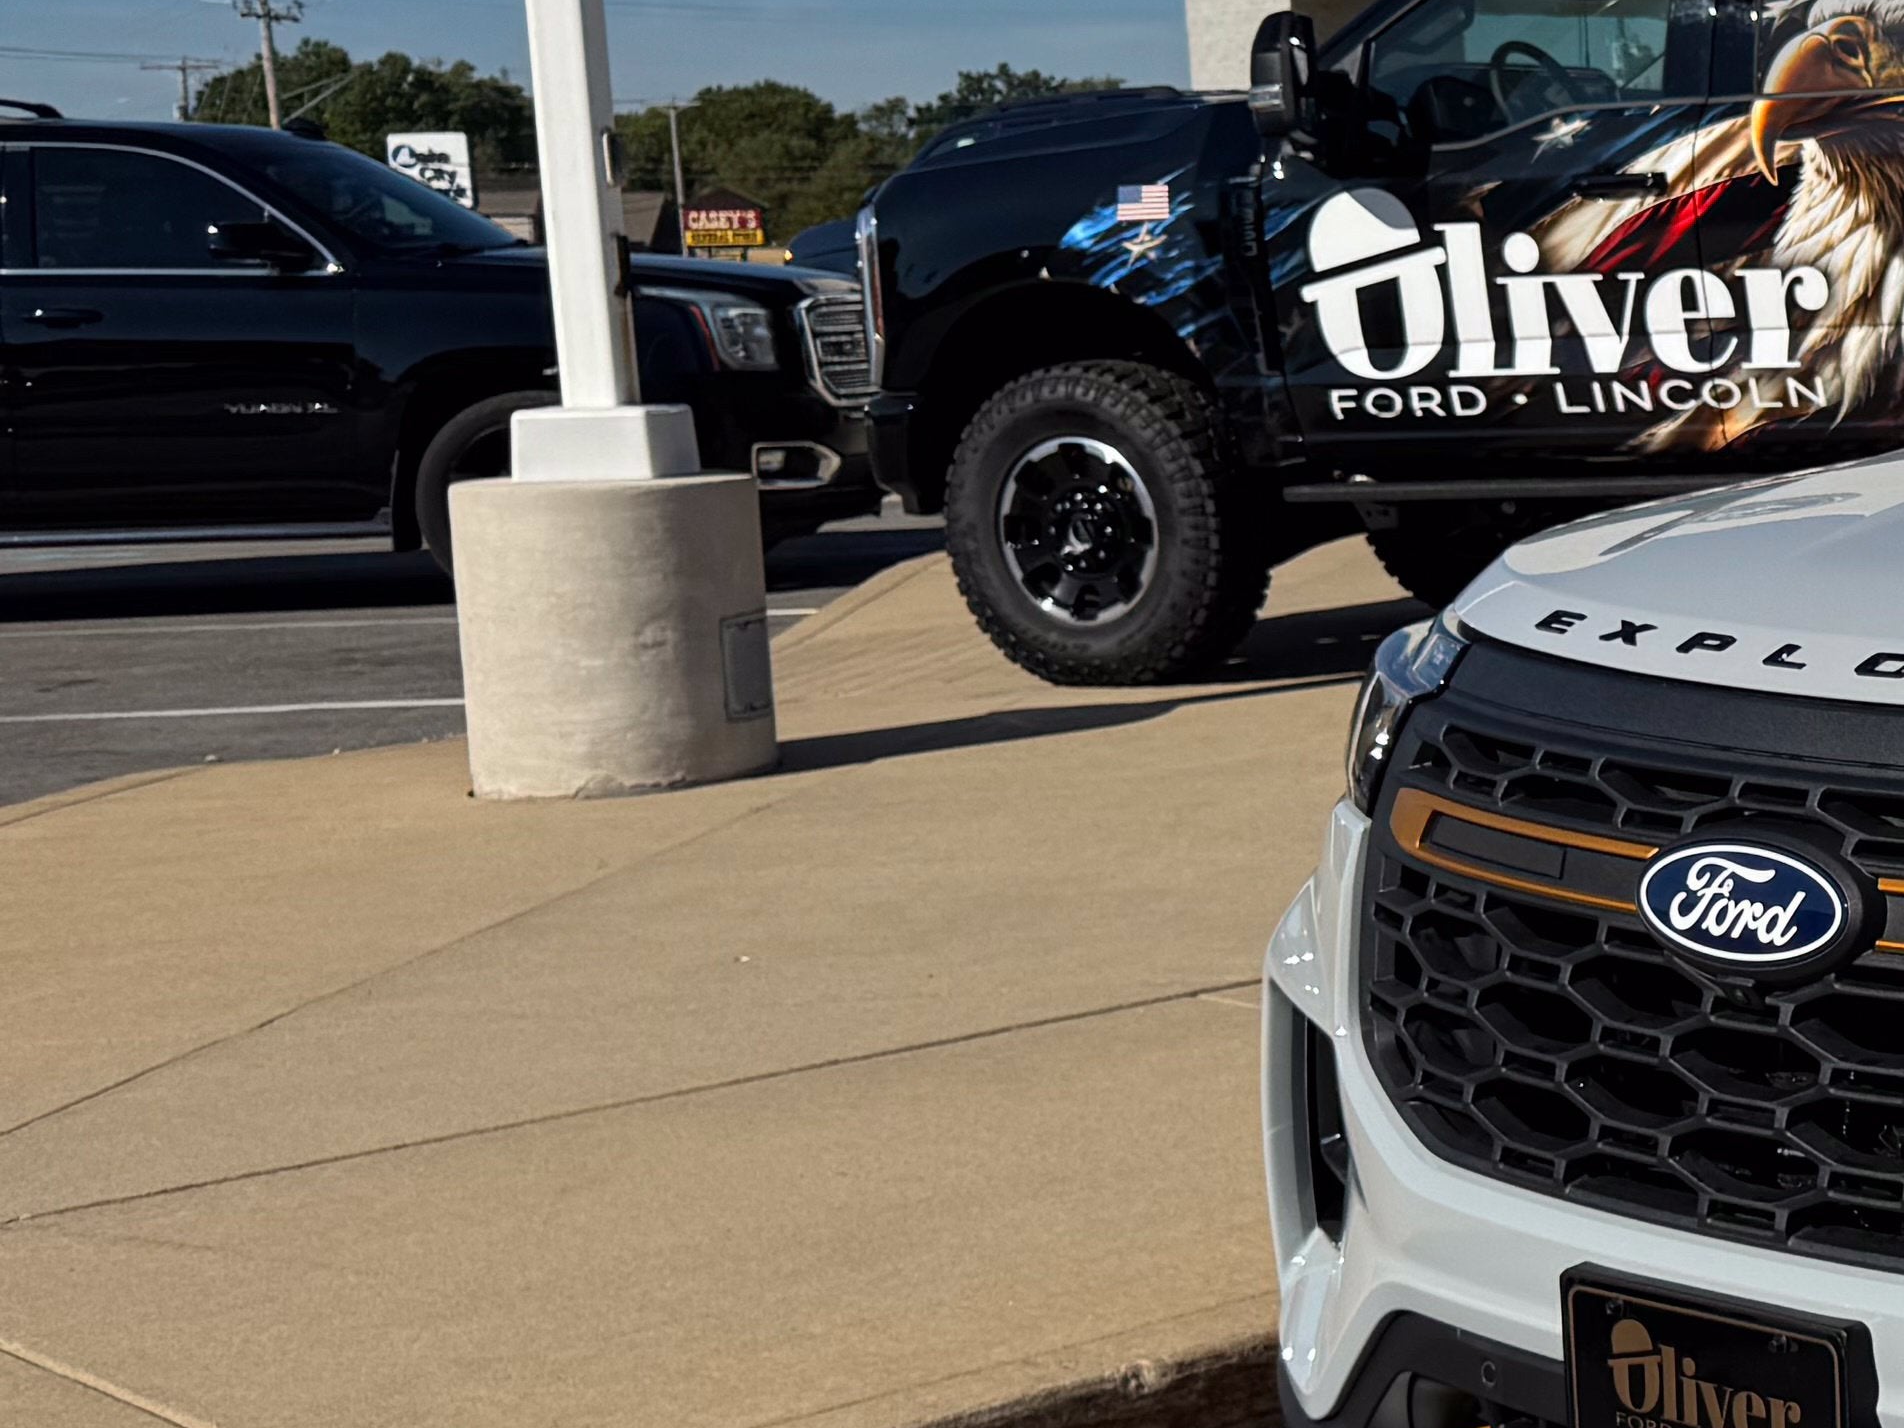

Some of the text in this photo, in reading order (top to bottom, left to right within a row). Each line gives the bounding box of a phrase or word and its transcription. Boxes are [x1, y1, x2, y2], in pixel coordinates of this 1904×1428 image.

[688, 209, 757, 230] CASEY'S
[1301, 188, 1829, 380] Oliver
[1327, 375, 1828, 421] FORD LINCOLN
[1669, 857, 1806, 947] Ford
